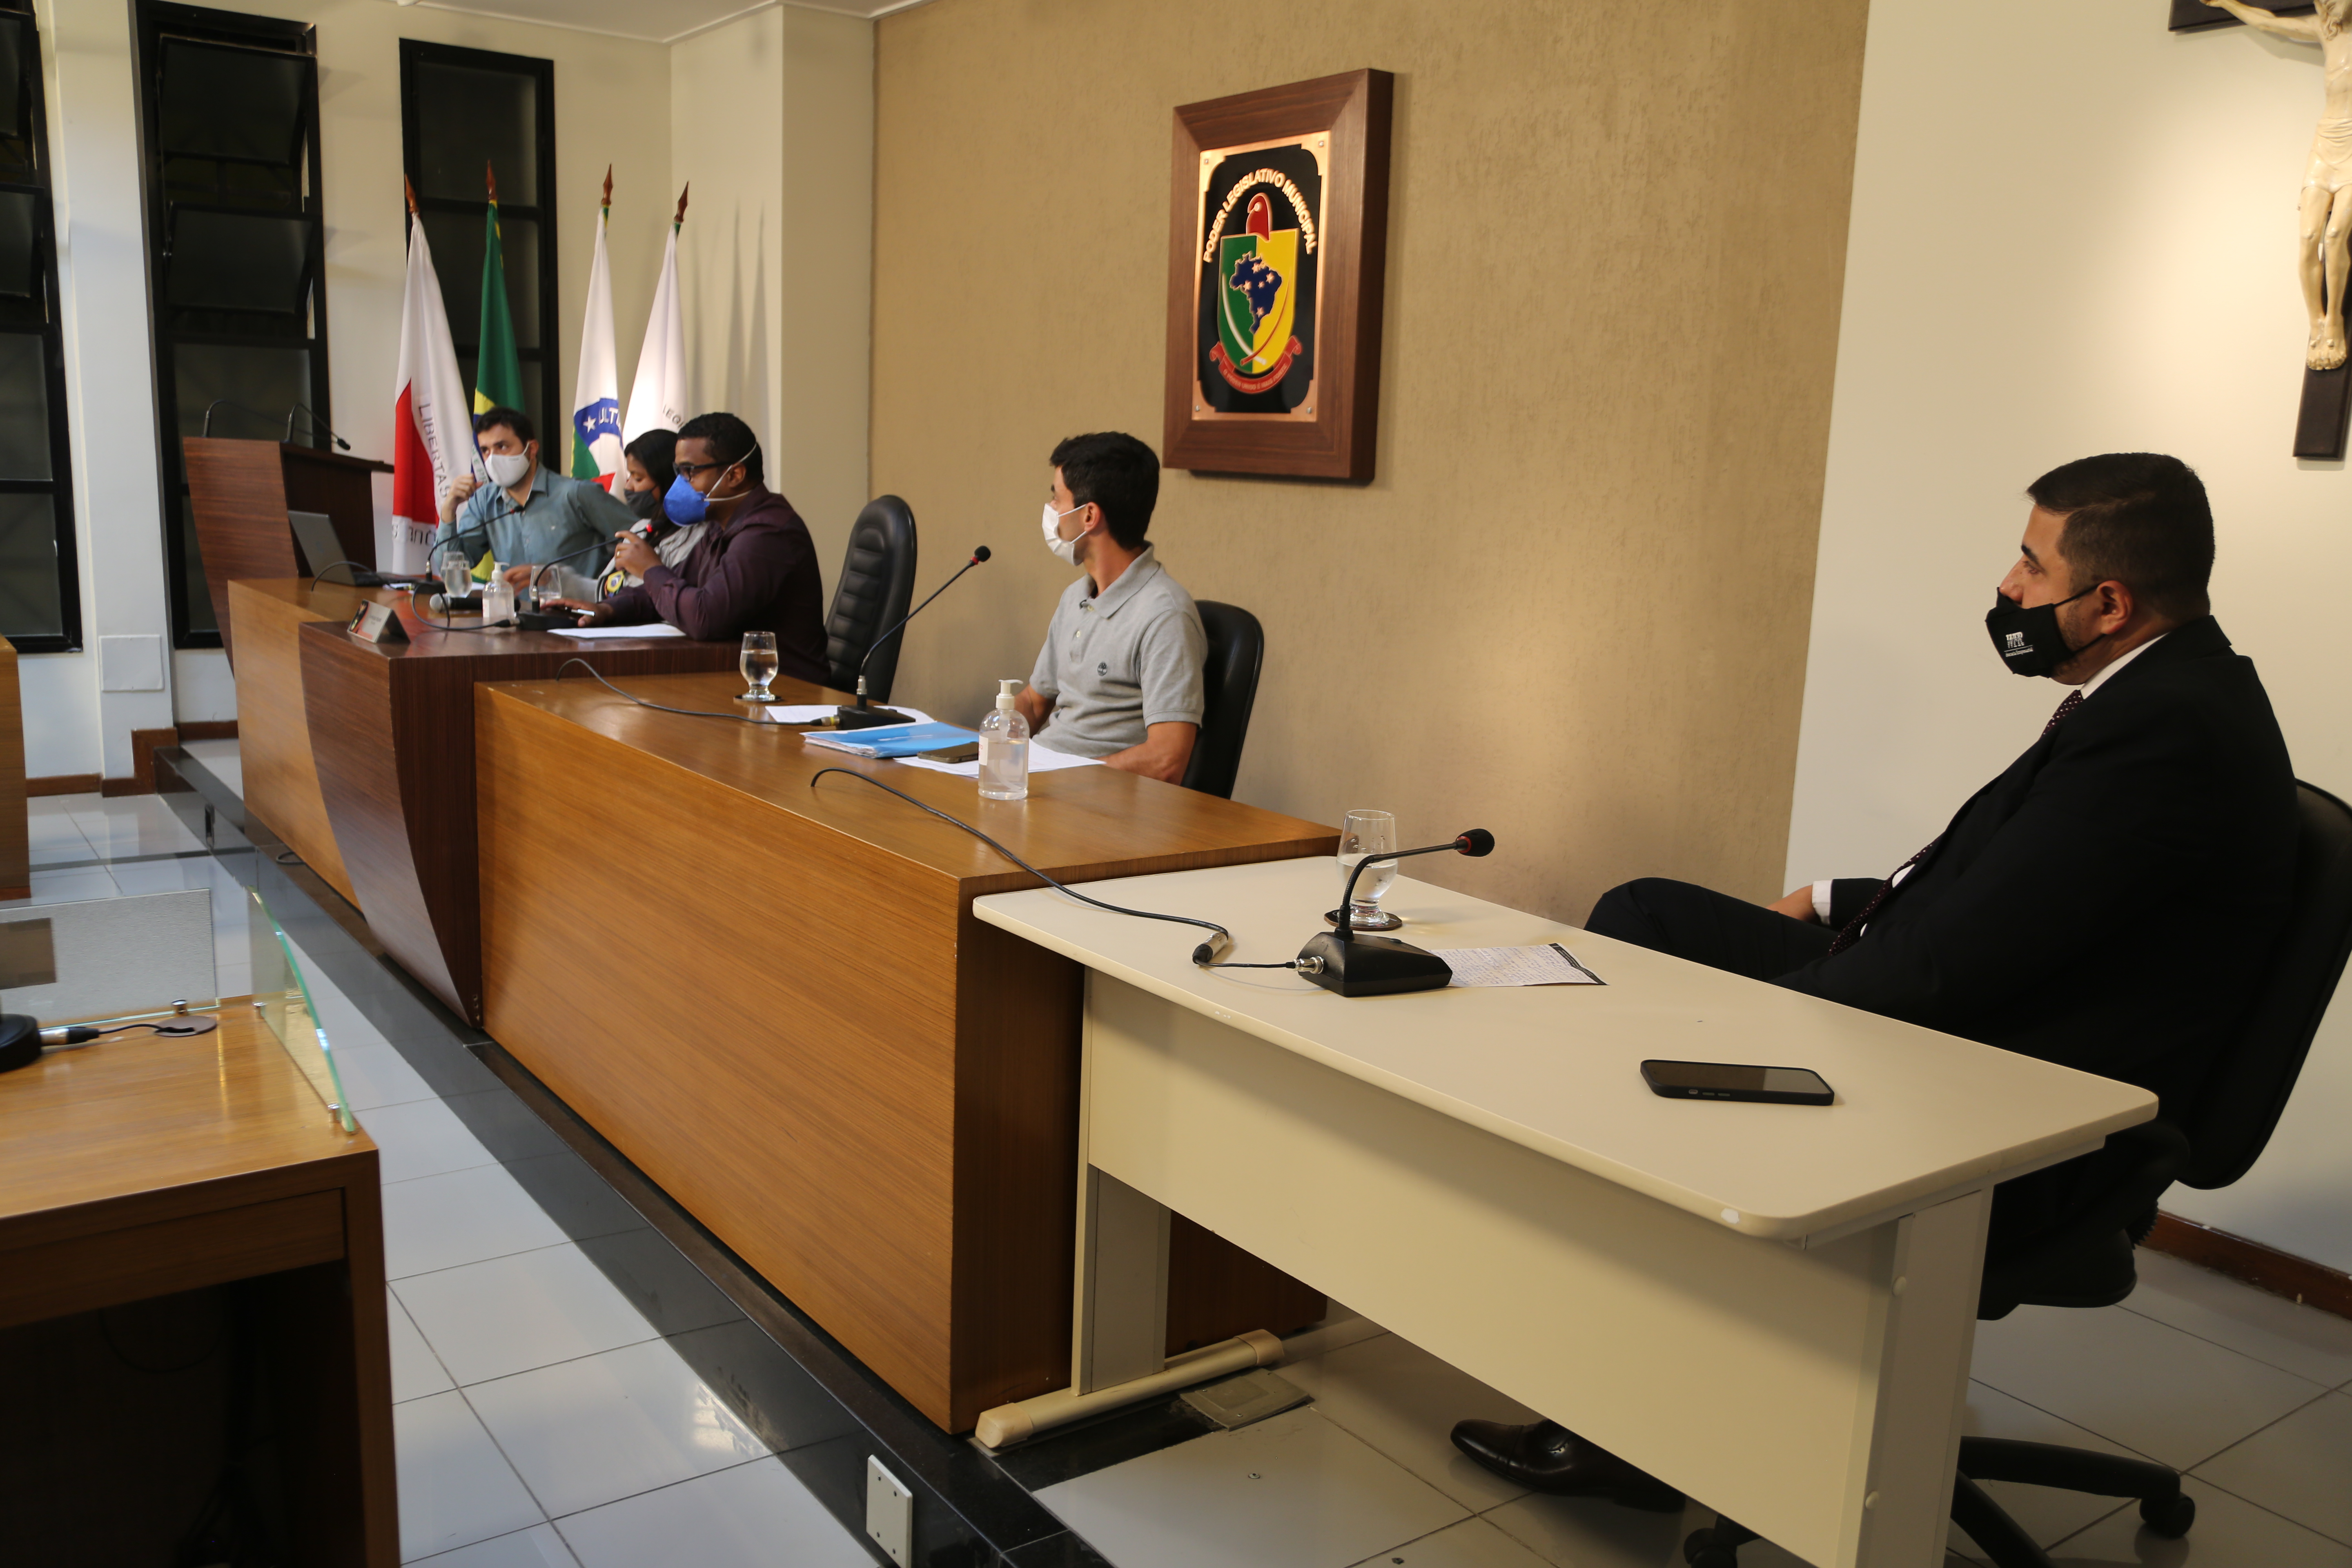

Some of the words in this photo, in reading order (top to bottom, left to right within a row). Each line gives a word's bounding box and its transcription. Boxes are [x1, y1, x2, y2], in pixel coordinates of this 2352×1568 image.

[1203, 209, 1229, 263] PODER
[1222, 168, 1286, 212] LEGISLATIVO
[1282, 179, 1317, 254] MUNICIPAL
[419, 403, 450, 498] LIBERTAS
